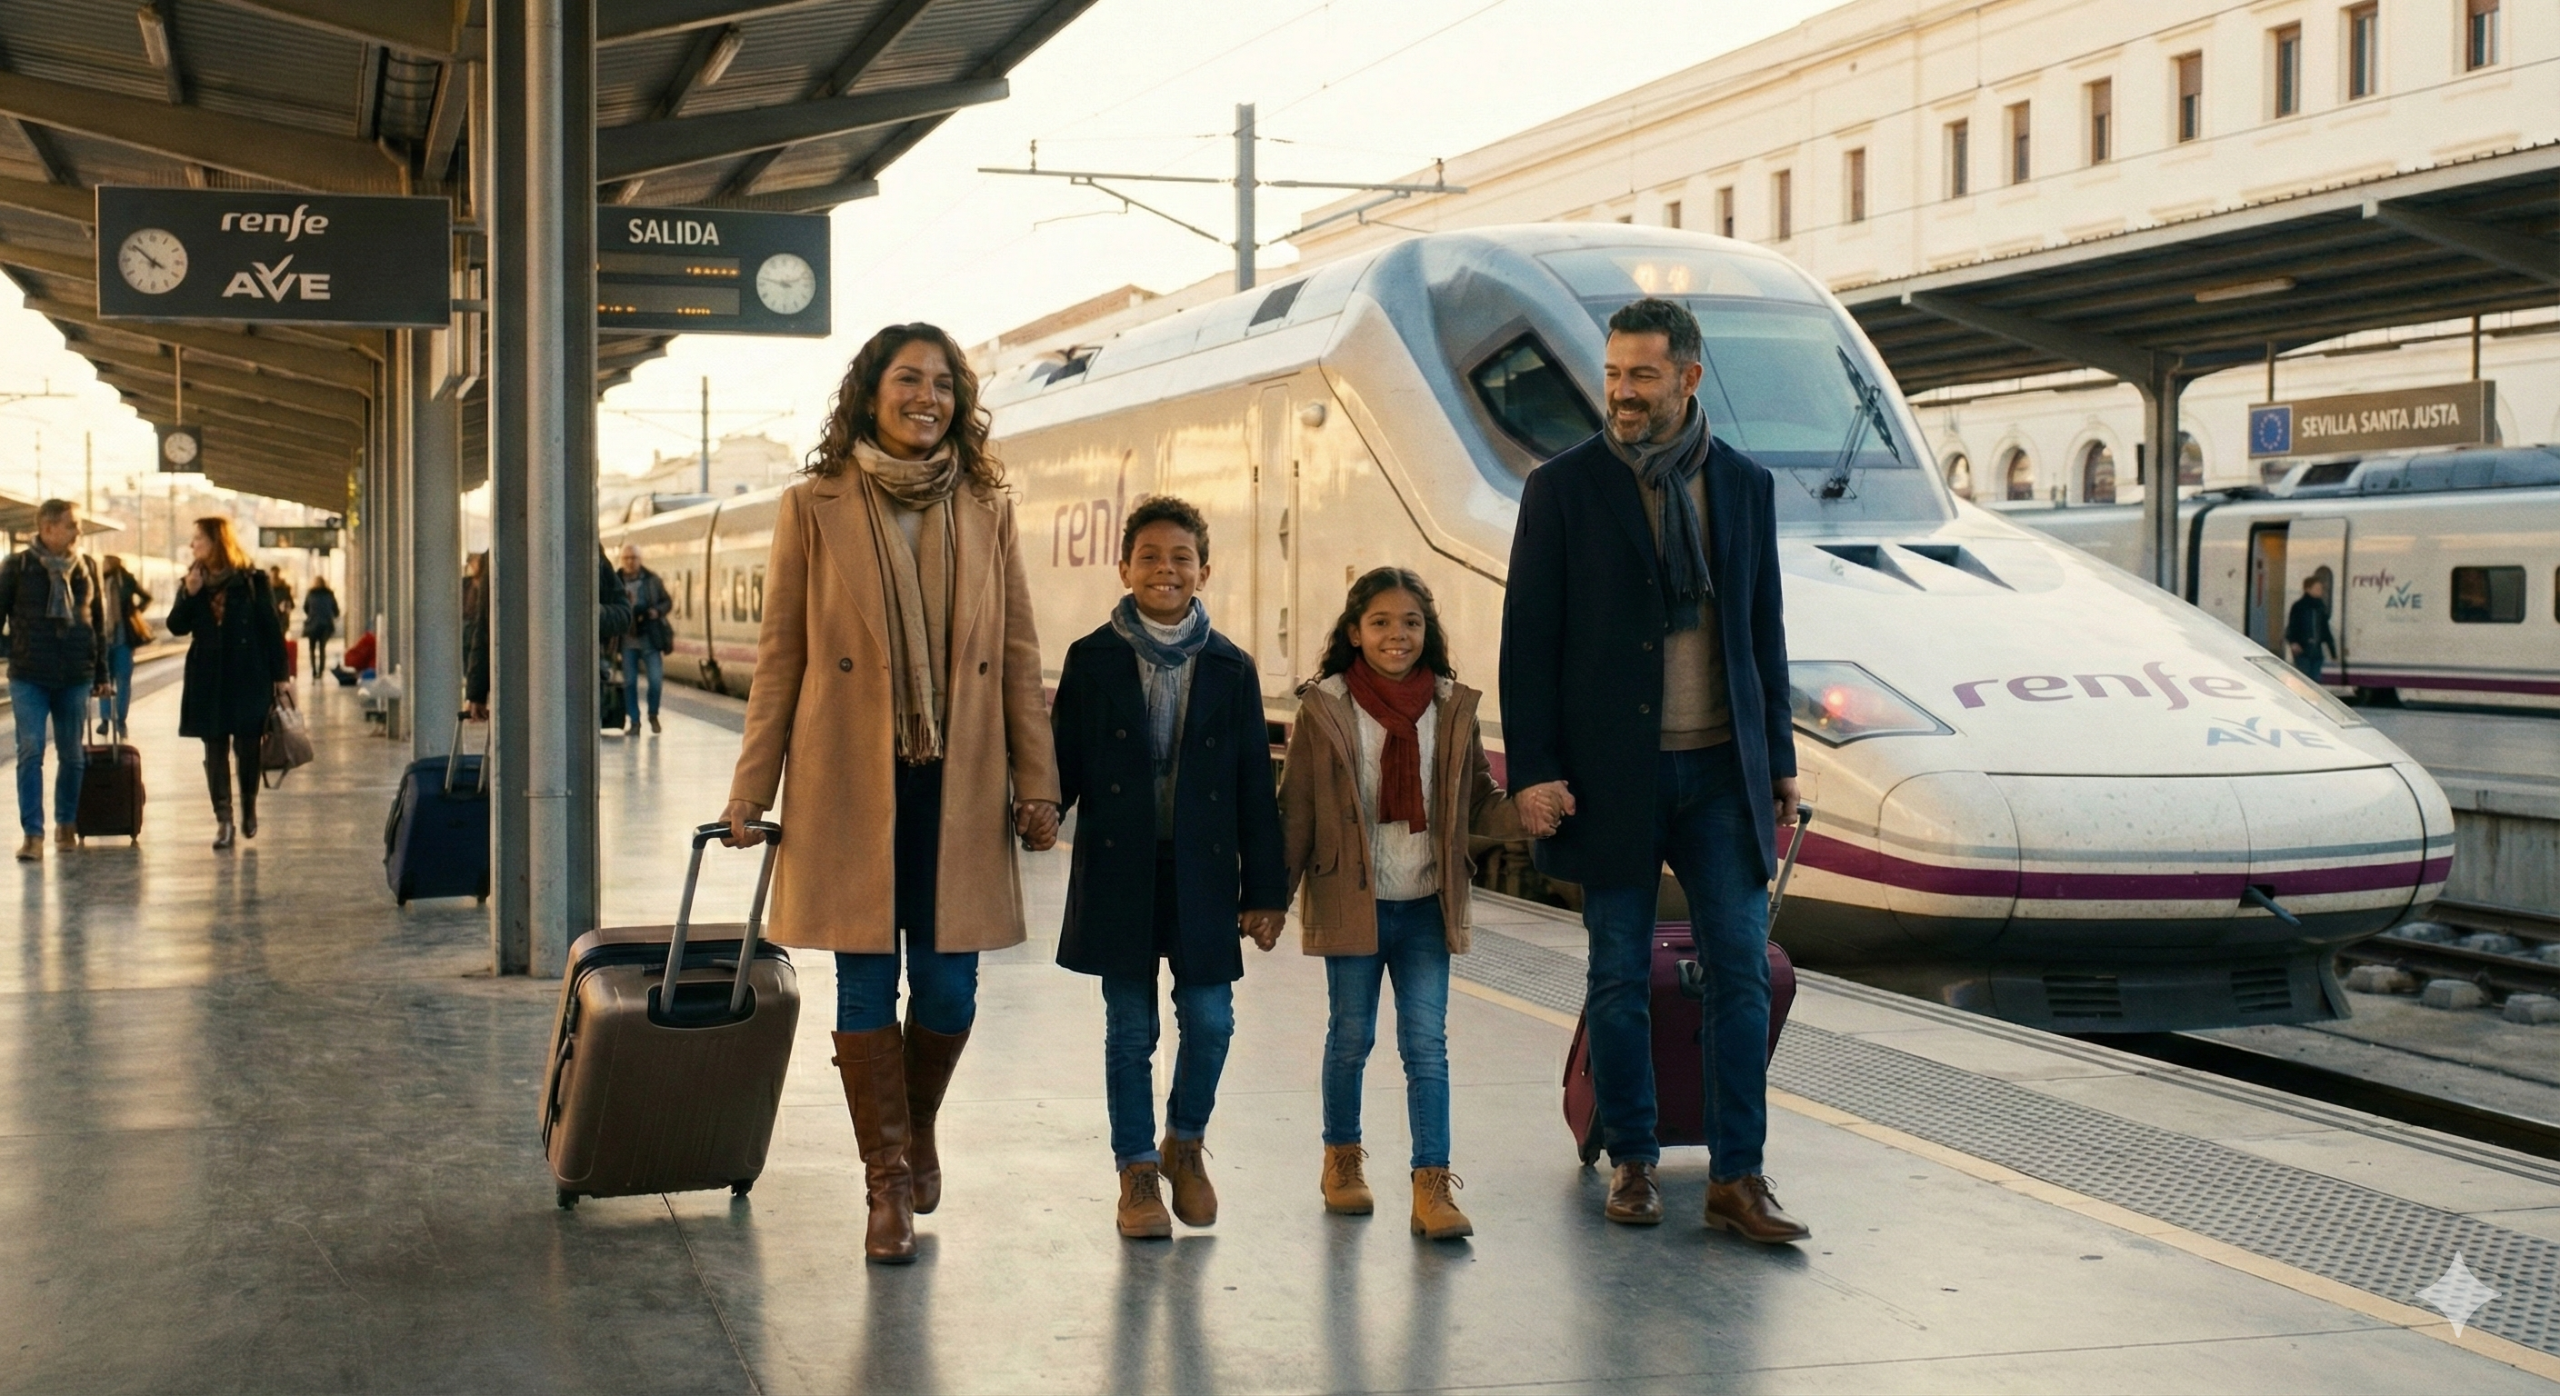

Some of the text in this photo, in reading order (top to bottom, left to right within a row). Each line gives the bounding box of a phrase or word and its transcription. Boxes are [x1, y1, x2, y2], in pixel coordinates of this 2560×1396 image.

[221, 204, 329, 242] renfe
[628, 218, 720, 246] SALIDA
[221, 253, 331, 303] AVE
[2301, 403, 2460, 438] SEVILLA SANTA JUSTA
[1052, 448, 1150, 568] renf
[2352, 568, 2396, 593] renfe
[2385, 580, 2423, 610] AVE
[1952, 661, 2256, 711] renfe
[2206, 716, 2335, 749] AVE
